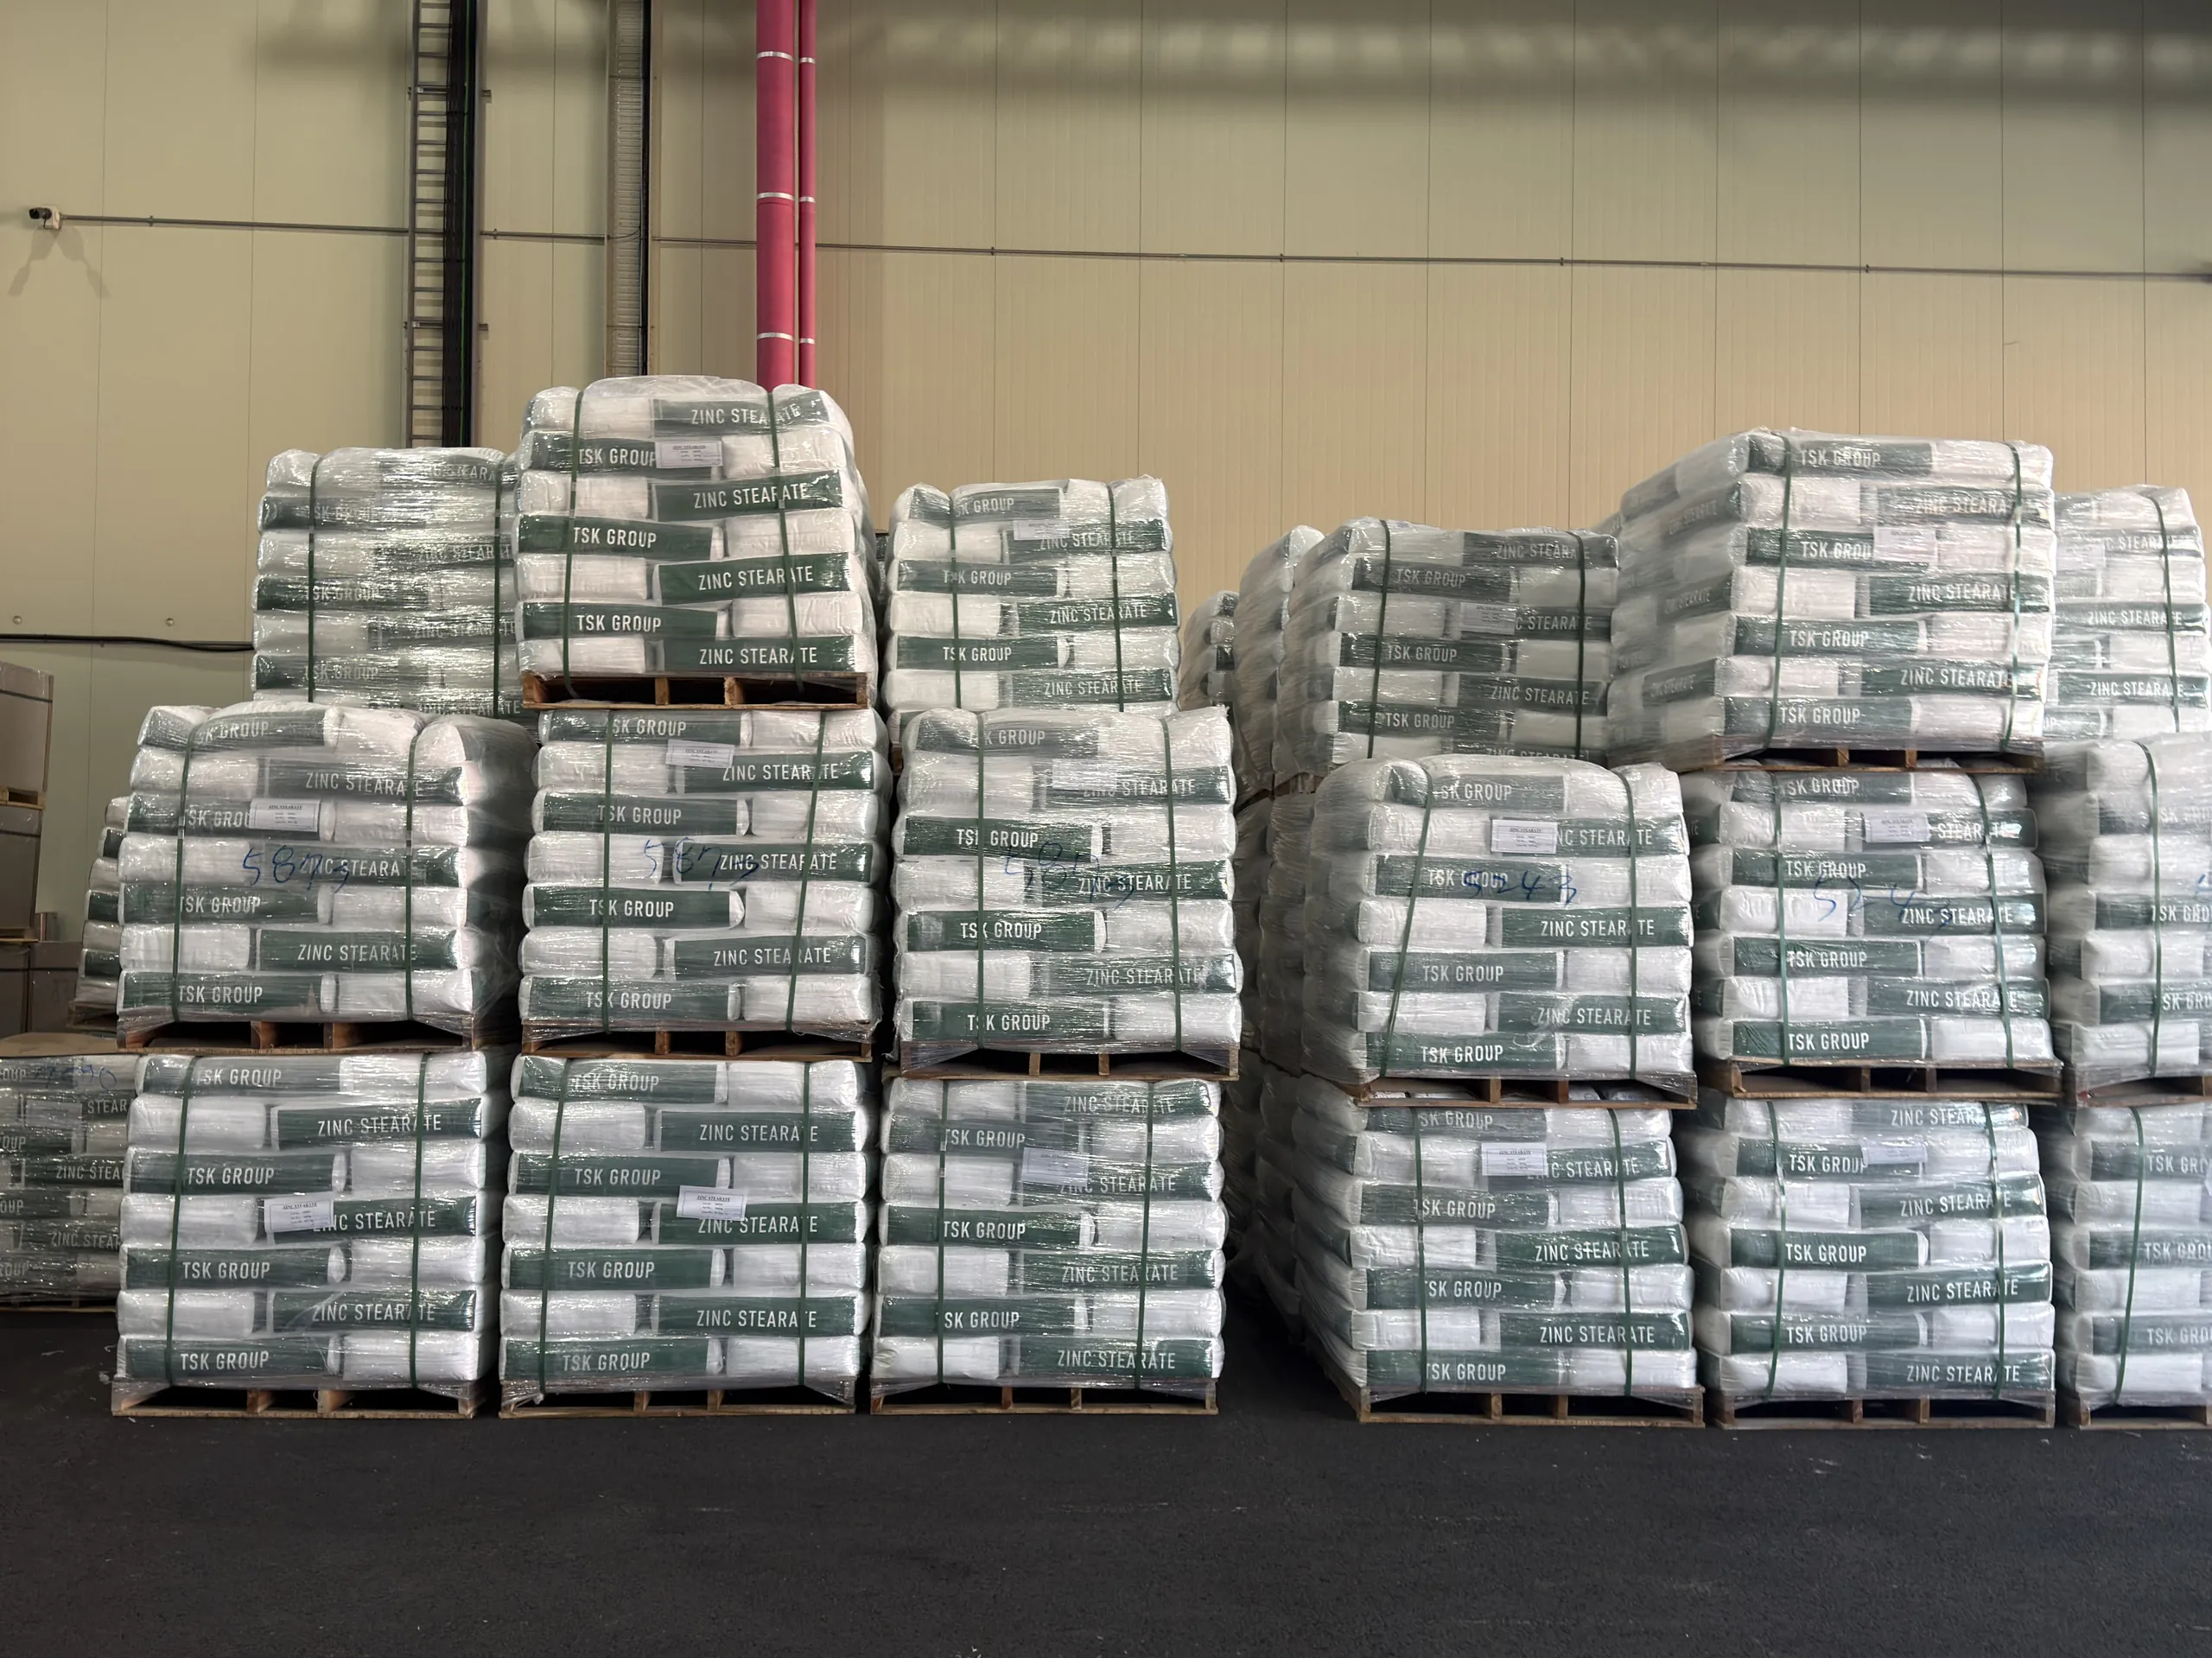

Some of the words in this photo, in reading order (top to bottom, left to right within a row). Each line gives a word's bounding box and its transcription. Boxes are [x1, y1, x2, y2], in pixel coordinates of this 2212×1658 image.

[691, 409, 725, 424] ZINC
[731, 403, 802, 424] STEAATE
[1801, 451, 1825, 465] TSK
[1833, 451, 1880, 467] GROUP
[694, 491, 727, 508] ZINC
[974, 498, 1014, 512] GROUP
[573, 527, 601, 544] TSK
[607, 529, 657, 548] GROUP
[1497, 546, 1524, 559] ZINC
[1801, 542, 1827, 557] TSK
[699, 573, 732, 590] ZINC
[944, 571, 965, 584] TK
[971, 571, 1011, 585] GROUP
[1397, 569, 1420, 583] TSK
[1426, 573, 1465, 588] GROUP
[1909, 586, 1941, 601] ZINC
[577, 615, 606, 631] TSK
[612, 616, 661, 632] GROUP
[1050, 610, 1079, 624] ZINC
[1528, 616, 1592, 631] STEARAE
[2089, 612, 2115, 623] ZINC
[1790, 631, 1815, 646] TSK
[1822, 631, 1868, 647] GROUP
[700, 649, 734, 664] ZINC
[741, 647, 817, 664] STEARTE
[972, 647, 1012, 660] GROUP
[1388, 645, 1410, 660] TSK
[1416, 648, 1457, 662] GROUP
[1902, 670, 1934, 685] ZINC
[1044, 683, 1072, 696] ZINC
[1491, 687, 1520, 700] ZINC
[2090, 683, 2117, 696] ZINC
[1386, 714, 1409, 727] TSK
[1414, 715, 1454, 727] GROUP
[1781, 708, 1806, 723] TSK
[1813, 708, 1860, 724] GROUP
[220, 722, 269, 738] GROUP
[637, 720, 686, 736] GROUP
[999, 729, 1045, 745] GROUP
[306, 772, 339, 789] ZINC
[723, 765, 756, 781] ZINC
[763, 765, 839, 779] STEARTE
[1465, 785, 1512, 800] GROUP
[1813, 779, 1859, 793] GROUP
[632, 807, 682, 824] GROUP
[990, 831, 1038, 847] GROUP
[721, 855, 753, 869] ZINC
[1787, 861, 1815, 876] TSK
[1820, 863, 1866, 878] GROUP
[1079, 877, 1112, 893] ZINC
[1429, 870, 1454, 886] TSK
[212, 897, 260, 913] GROUP
[625, 900, 674, 917] GROUP
[1903, 909, 1933, 924] ZINC
[995, 923, 1041, 938] GROUP
[1541, 921, 1573, 937] ZINC
[1581, 921, 1654, 936] STEARTE
[298, 944, 332, 961] ZINC
[714, 950, 747, 966] ZINC
[1787, 951, 1815, 967] TSK
[1821, 952, 1866, 968] GROUP
[1087, 969, 1120, 984] ZINC
[1423, 966, 1448, 981] TSK
[1455, 966, 1503, 981] GROUP
[179, 986, 206, 1001] TSK
[213, 987, 263, 1003] GROUP
[621, 994, 671, 1009] GROUP
[1907, 990, 1939, 1006] ZINC
[2163, 997, 2180, 1010] SK
[1001, 1015, 1050, 1030] GROUP
[1538, 1007, 1570, 1023] ZINC
[1789, 1034, 1815, 1050] TSK
[1821, 1034, 1869, 1049] GROUP
[1421, 1047, 1447, 1062] TSK
[1454, 1045, 1503, 1061] GROUP
[198, 1070, 222, 1084] TSK
[230, 1070, 282, 1086] GROUP
[573, 1074, 603, 1089] TSK
[607, 1076, 659, 1091] GROUP
[88, 1100, 126, 1113] STEAR
[1065, 1096, 1097, 1110] ZINC
[1421, 1113, 1441, 1127] SK
[1446, 1114, 1492, 1128] GROUP
[1891, 1110, 1923, 1125] ZINC
[319, 1120, 353, 1135] ZINC
[700, 1125, 734, 1140] ZINC
[741, 1125, 818, 1141] STEARAE
[944, 1129, 970, 1145] TSK
[976, 1130, 1025, 1147] GROUP
[1789, 1155, 1815, 1171] TSK
[2147, 1156, 2173, 1172] TSK
[57, 1166, 84, 1178] ZINC
[188, 1168, 214, 1184] TSK
[222, 1168, 275, 1184] GROUP
[575, 1169, 603, 1185] TSK
[609, 1169, 661, 1185] GROUP
[1446, 1201, 1495, 1218] GROUP
[1901, 1199, 1934, 1217] ZINC
[699, 1217, 733, 1234] ZINC
[740, 1217, 817, 1232] STEARAE
[944, 1222, 969, 1237] TSK
[976, 1223, 1026, 1239] GROUP
[51, 1233, 78, 1246] ZINC
[1535, 1245, 1568, 1261] ZINC
[1786, 1245, 1813, 1261] TSK
[1818, 1246, 1866, 1261] GROUP
[2144, 1242, 2171, 1258] TSK
[183, 1263, 211, 1279] TSK
[219, 1263, 270, 1279] GROUP
[569, 1261, 596, 1278] TSK
[603, 1261, 655, 1278] GROUP
[1062, 1266, 1095, 1282] ZINC
[1453, 1282, 1502, 1298] GROUP
[1908, 1286, 1940, 1302] ZINC
[313, 1305, 347, 1321] ZINC
[697, 1310, 731, 1327] ZINC
[738, 1310, 817, 1327] STEARAE
[944, 1313, 964, 1328] SK
[970, 1312, 1020, 1327] GROUP
[1541, 1327, 1573, 1343] ZINC
[1787, 1327, 1814, 1343] TSK
[1820, 1327, 1866, 1343] GROUP
[2147, 1329, 2173, 1344] TSK
[181, 1353, 208, 1369] TSK
[216, 1351, 269, 1369] GROUP
[563, 1355, 590, 1371] TSK
[598, 1353, 650, 1369] GROUP
[1058, 1350, 1090, 1366] ZINC
[1457, 1364, 1506, 1380] GROUP
[1908, 1366, 1940, 1381] ZINC
